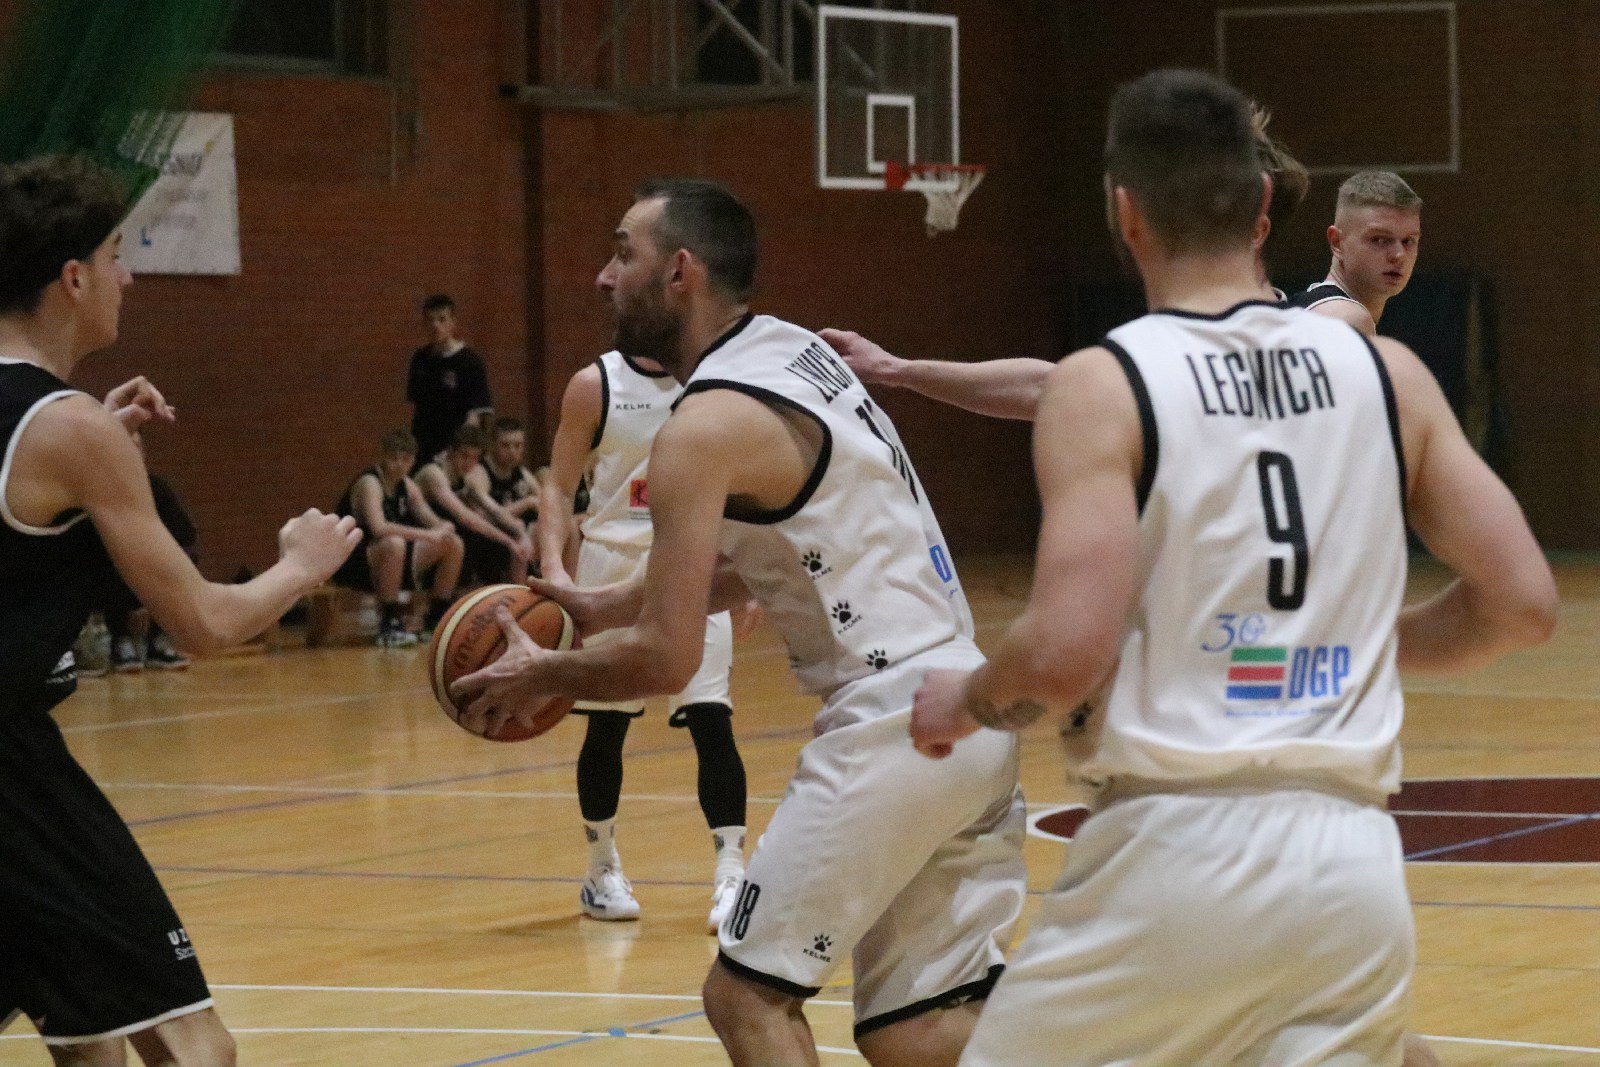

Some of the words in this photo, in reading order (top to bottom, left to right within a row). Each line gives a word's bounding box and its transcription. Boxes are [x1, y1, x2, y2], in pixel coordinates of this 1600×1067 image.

[1185, 349, 1336, 420] LEGNICA
[1257, 450, 1310, 611] 9
[1289, 645, 1349, 698] DGP
[729, 880, 760, 940] 18
[803, 949, 831, 962] KELME
